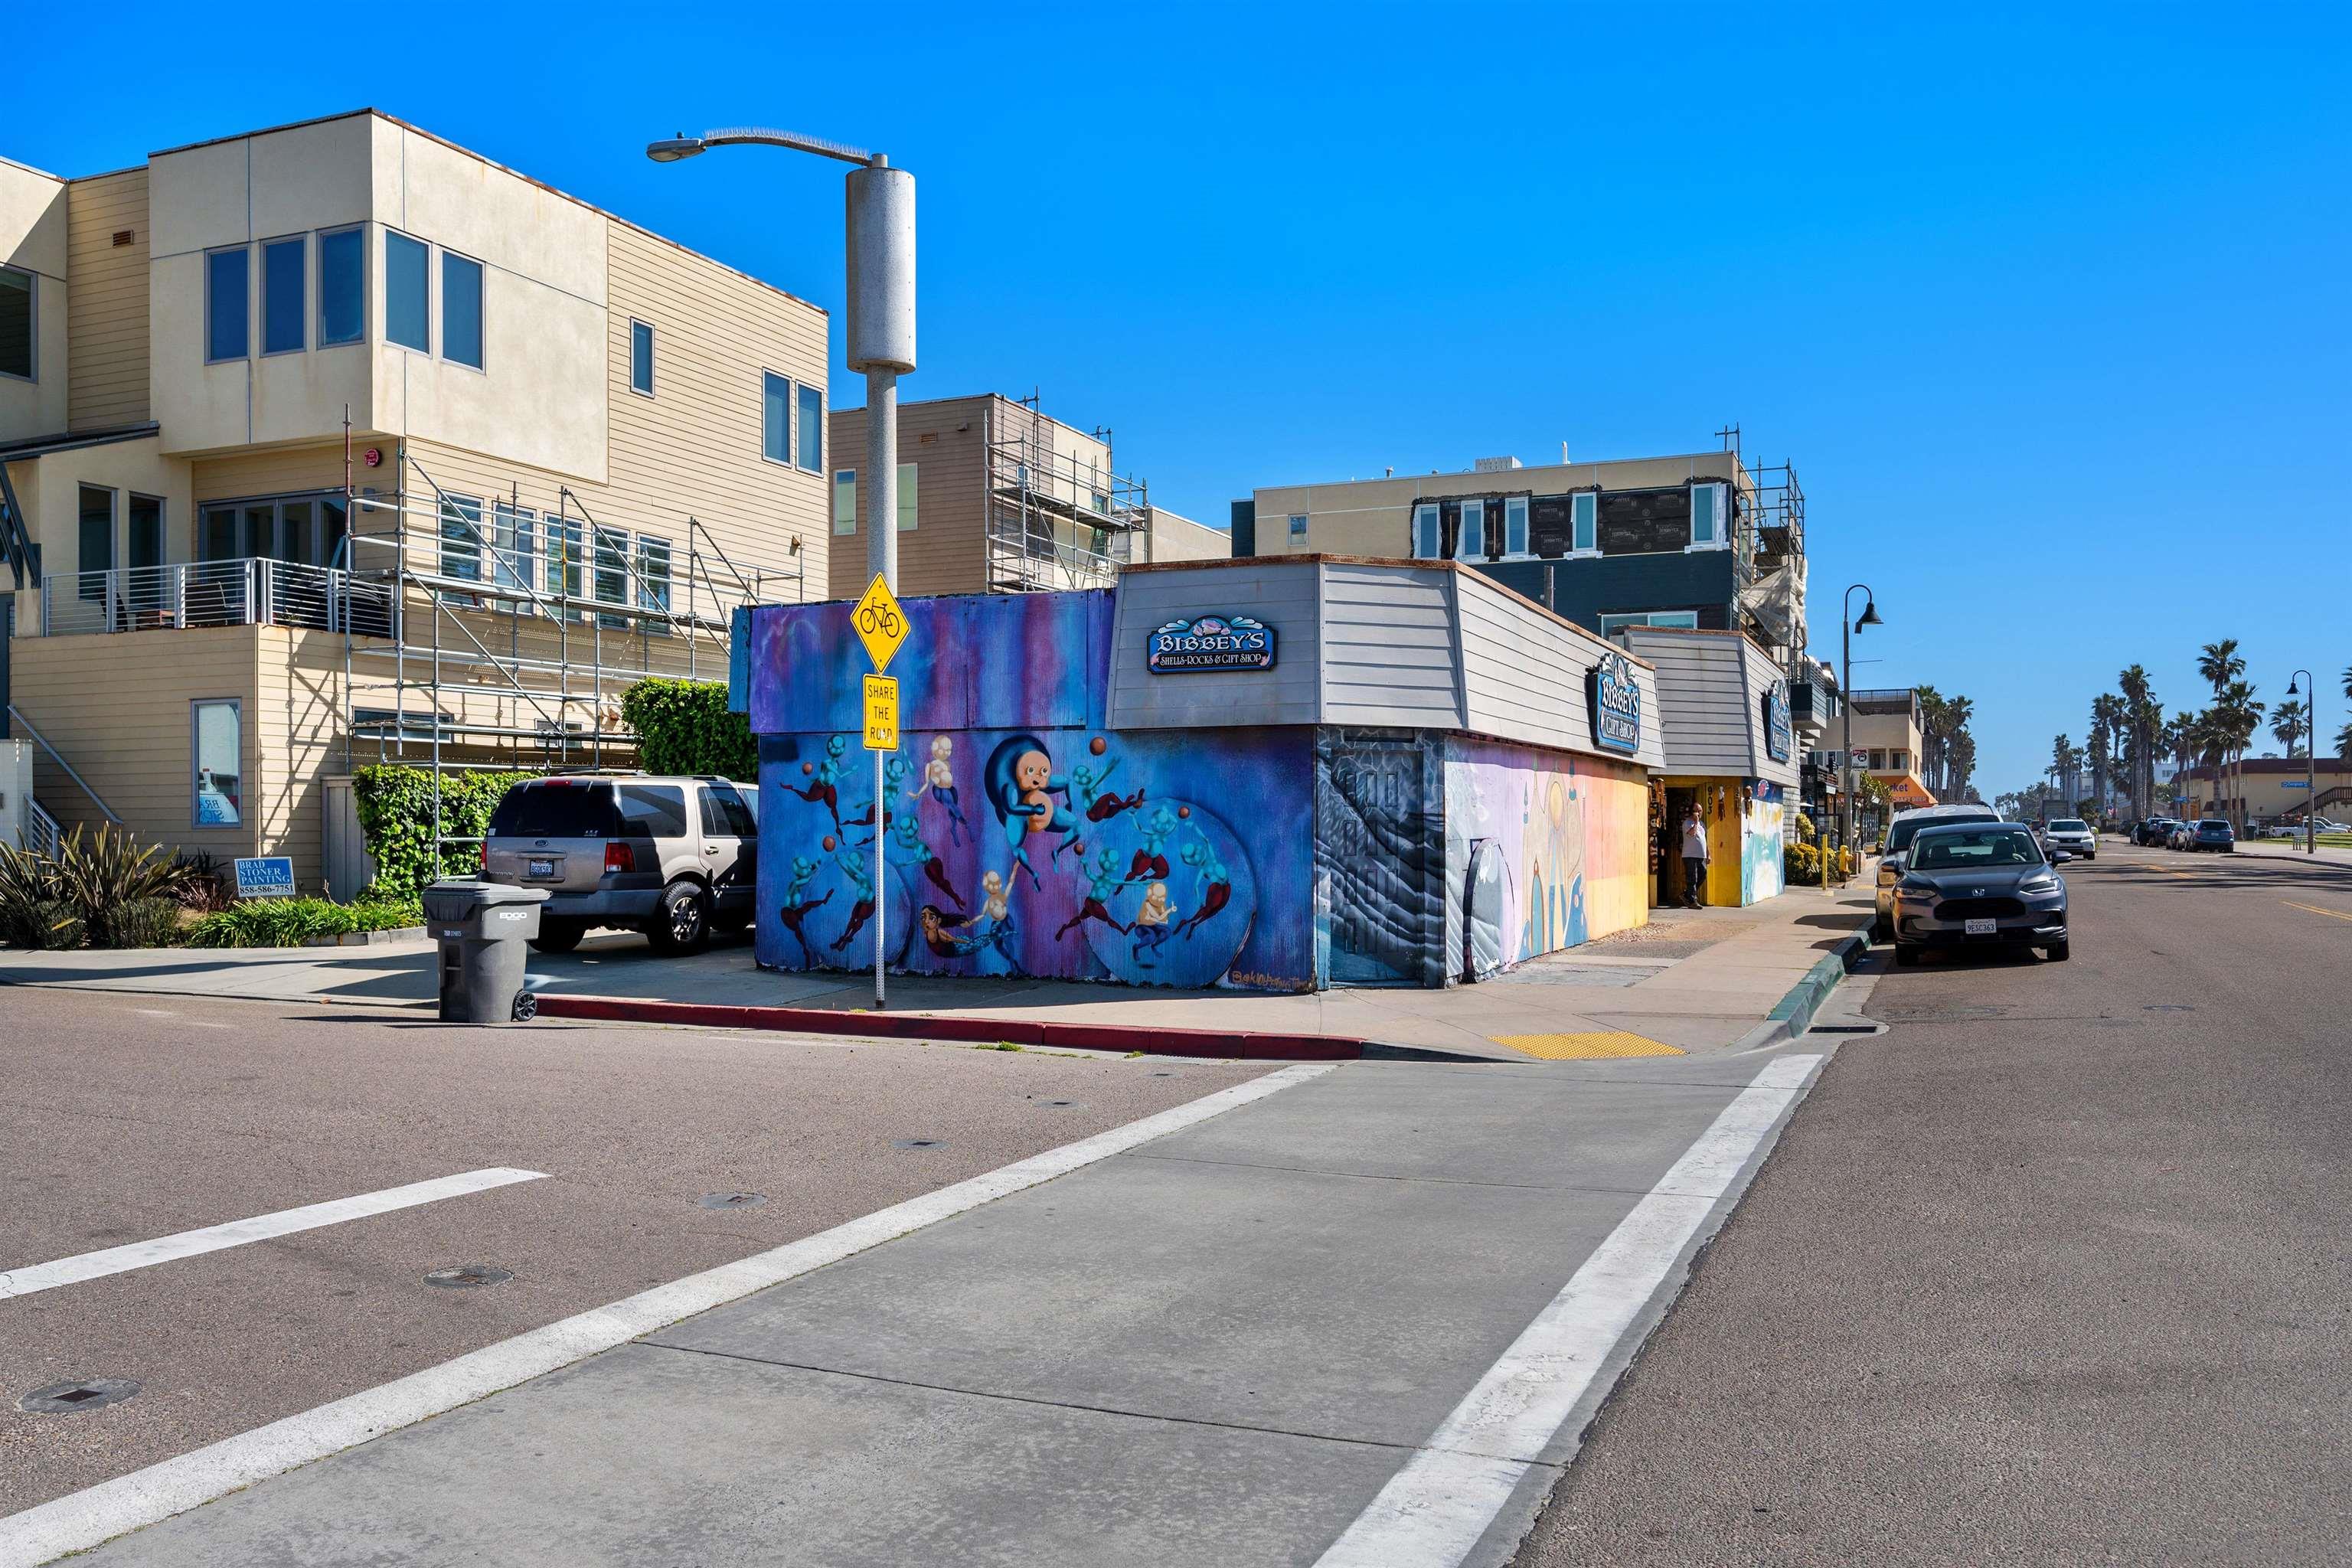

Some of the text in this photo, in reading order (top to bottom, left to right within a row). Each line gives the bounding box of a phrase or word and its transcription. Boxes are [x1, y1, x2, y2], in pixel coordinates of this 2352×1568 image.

[1157, 632, 1264, 652] BIBBEY'S
[1160, 653, 1262, 665] SHELLS-ROCKS & GIFT SHOP
[868, 684, 894, 700] SHARE
[1602, 678, 1638, 716] BIBBEY'S
[874, 706, 890, 720] THE
[1606, 717, 1635, 739] GIFT SHOP
[239, 861, 265, 869] BRAD
[240, 867, 281, 877] STONER
[241, 874, 290, 884] PAINTING
[240, 884, 293, 893] 858-586-7751
[1967, 923, 1994, 932] 9ESC363
